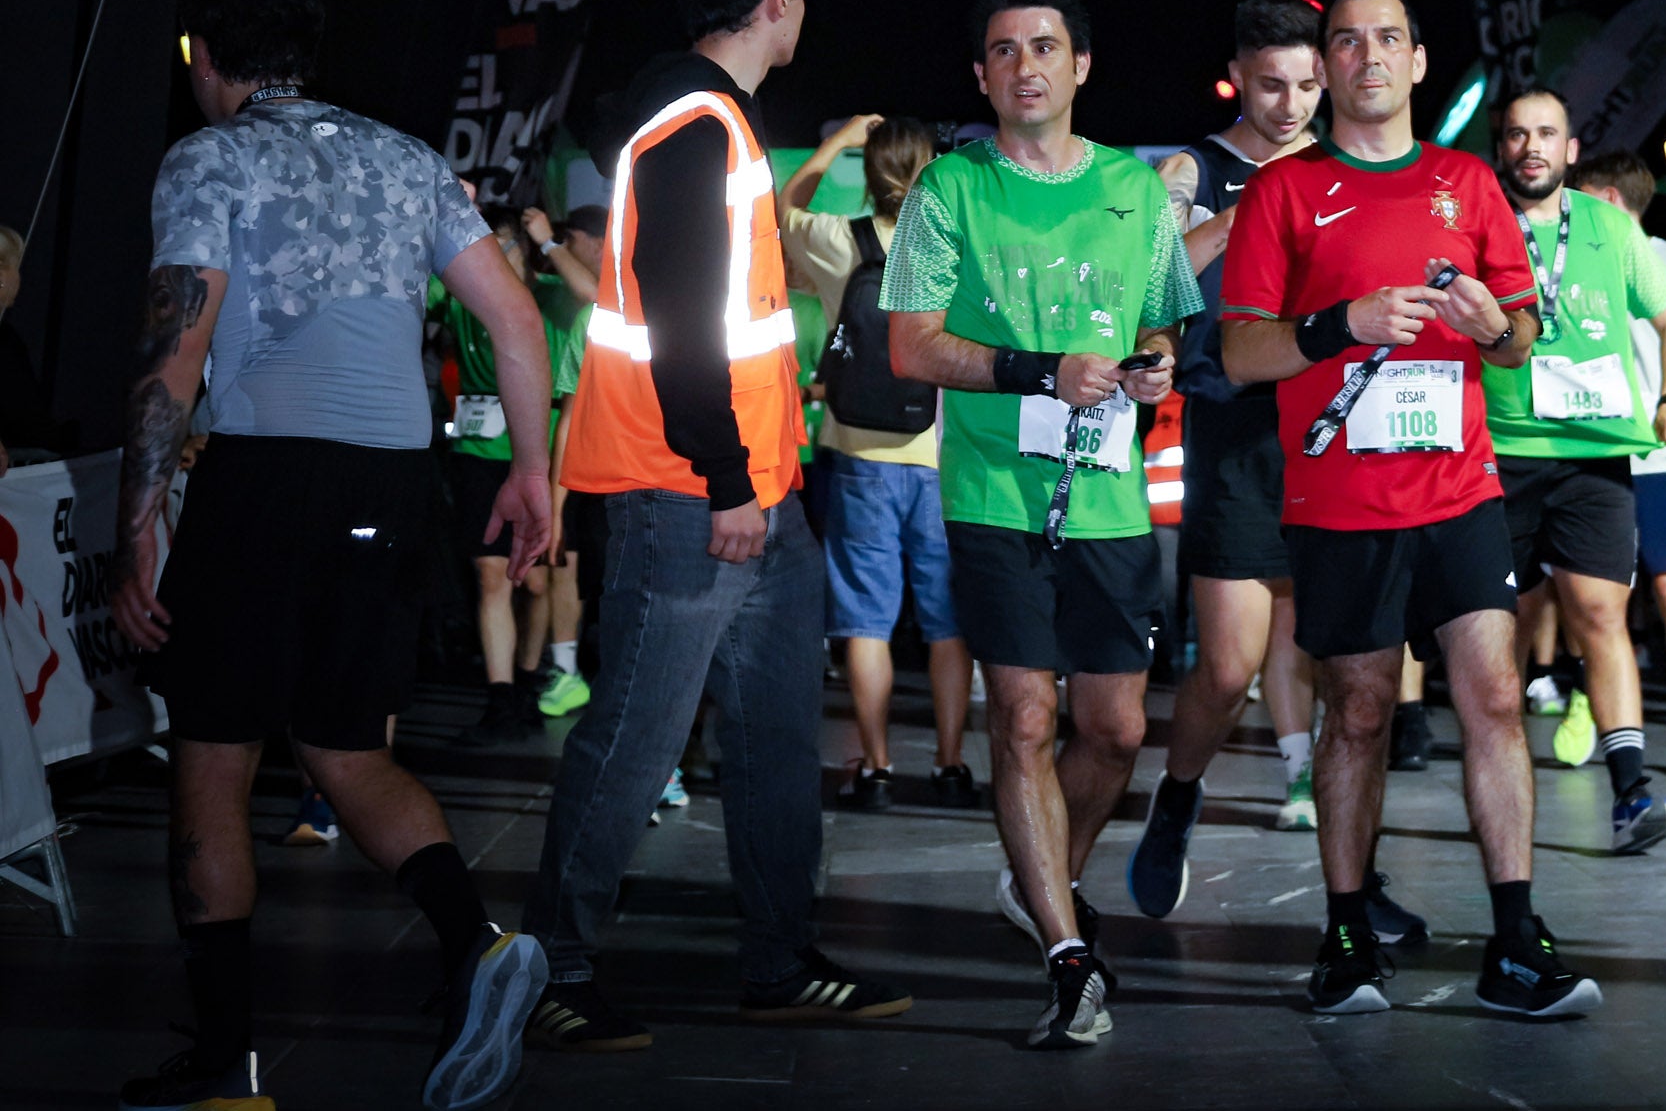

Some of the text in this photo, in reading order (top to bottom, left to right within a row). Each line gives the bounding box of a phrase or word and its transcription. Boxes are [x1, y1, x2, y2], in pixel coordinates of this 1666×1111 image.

[1451, 369, 1458, 383] 3
[1333, 370, 1366, 410] FINISHER
[1395, 388, 1426, 403] CÉSAR
[1067, 405, 1105, 422] AKAITZ
[1385, 410, 1438, 437] 1108
[1063, 425, 1103, 454] 86
[53, 497, 77, 554] EL
